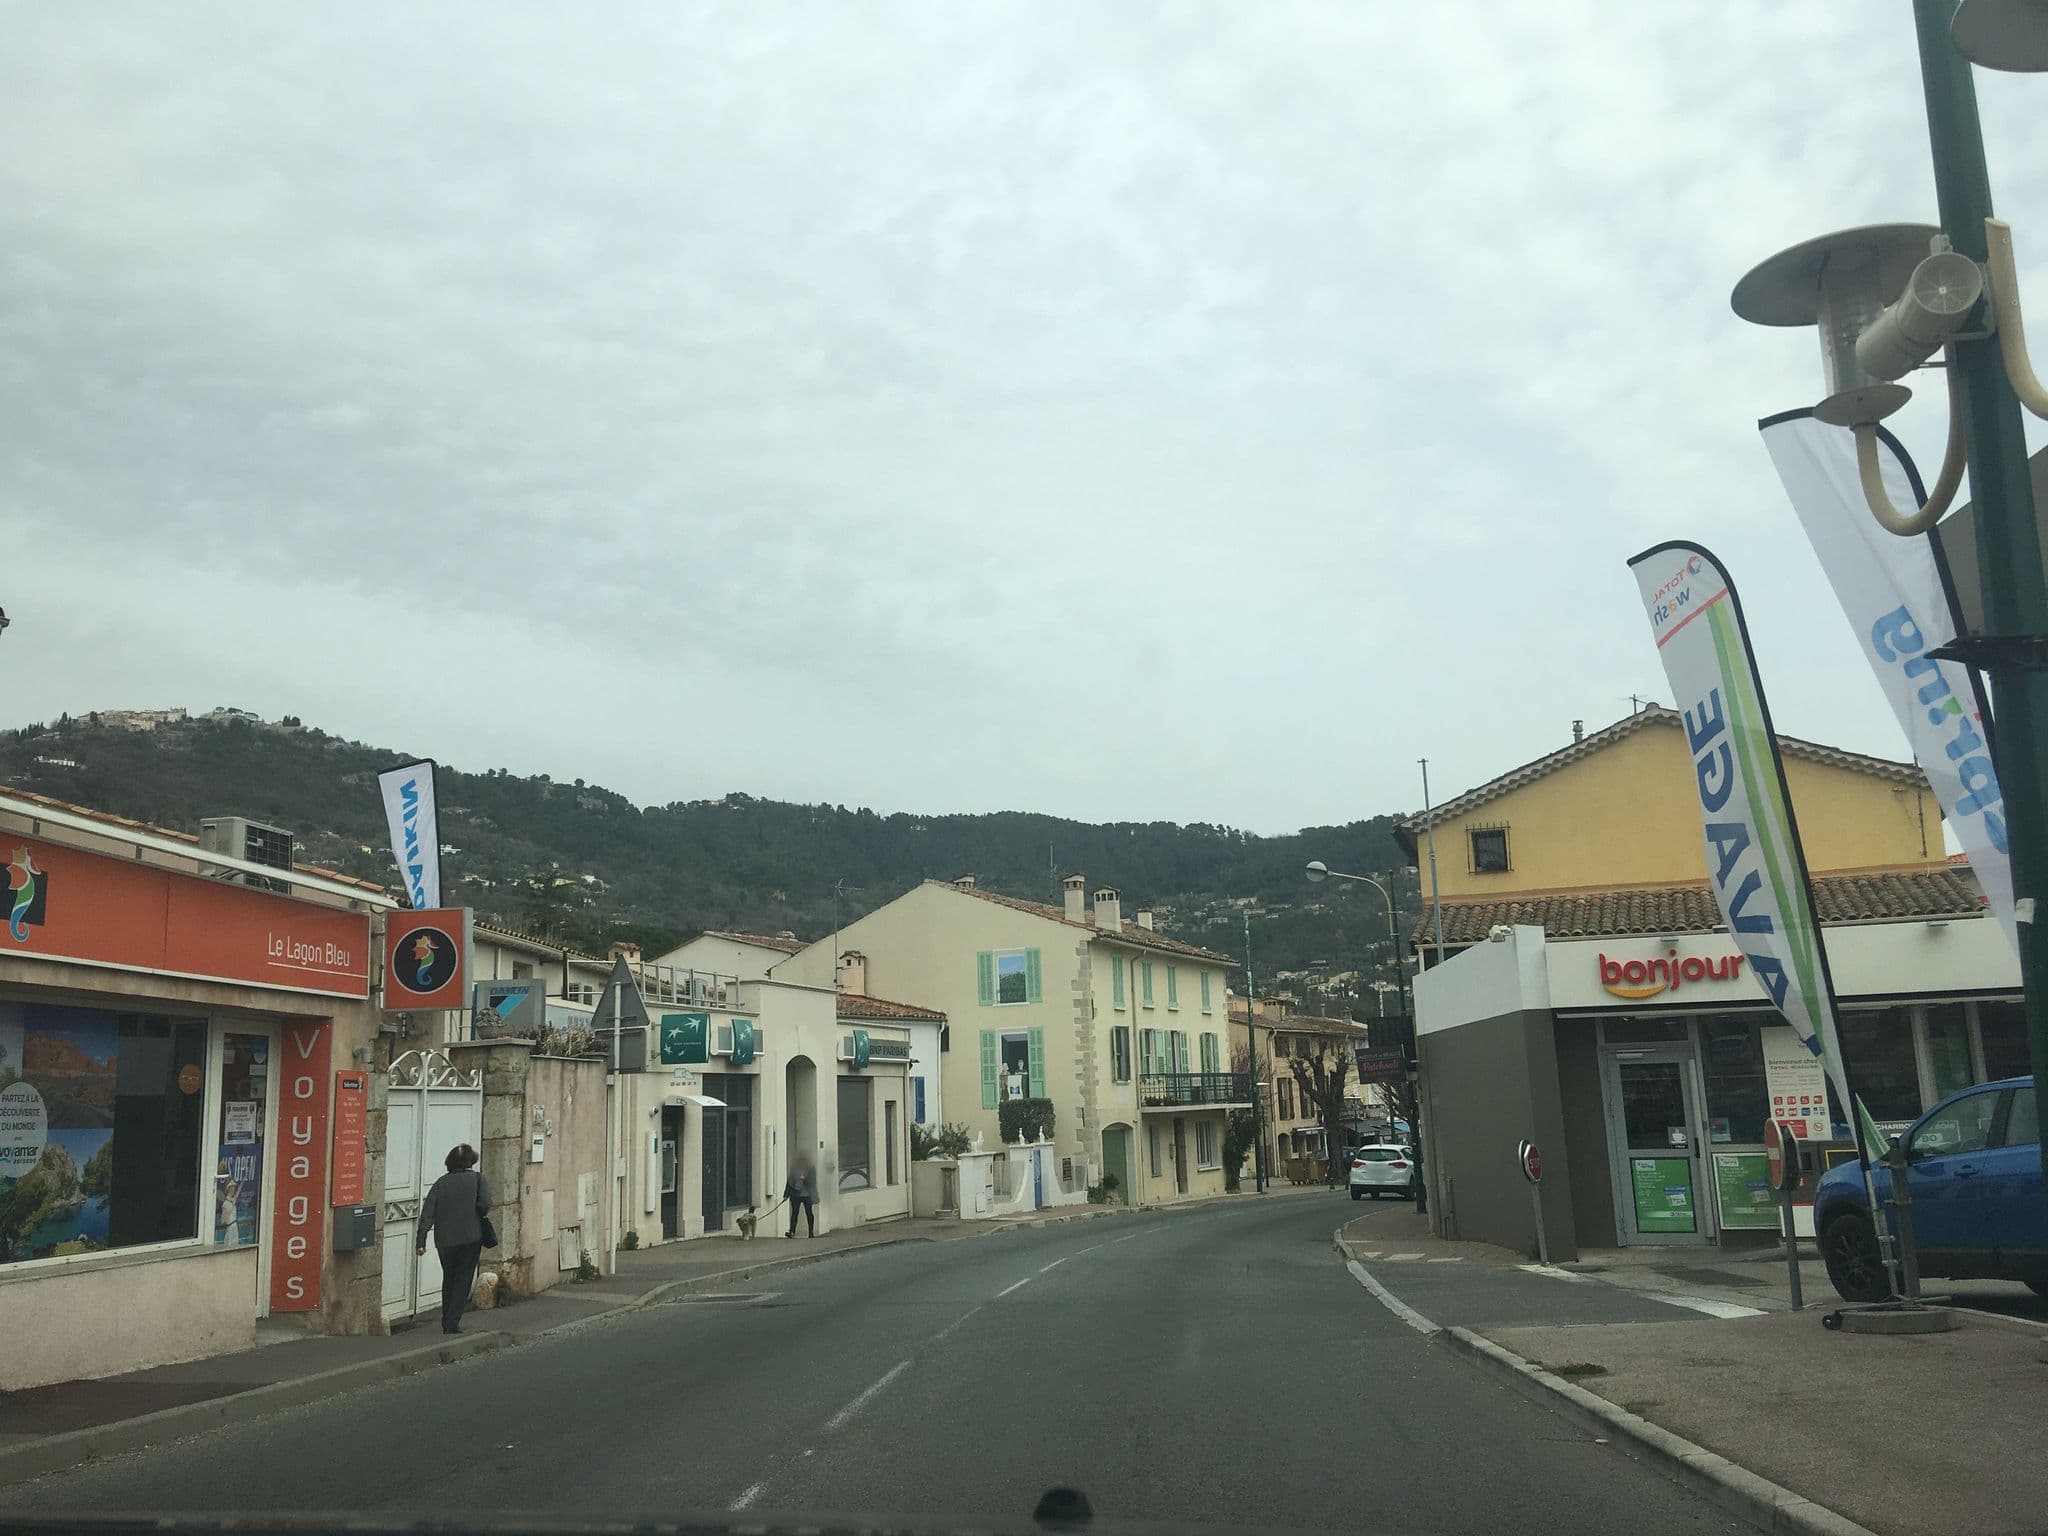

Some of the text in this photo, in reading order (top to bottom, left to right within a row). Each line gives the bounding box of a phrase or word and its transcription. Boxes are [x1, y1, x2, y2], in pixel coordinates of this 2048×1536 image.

[268, 931, 350, 967] Le Lagon Bleu
[1599, 949, 1745, 991] bonjour
[490, 986, 529, 995] DAIKIN
[883, 1045, 907, 1057] PARIBAS
[1, 1094, 25, 1103] PARTEZ
[1, 1121, 36, 1131] DU MONDE
[1877, 1122, 1914, 1131] CHARBO
[234, 1155, 257, 1182] OPEN
[286, 1029, 320, 1299] Voyages
